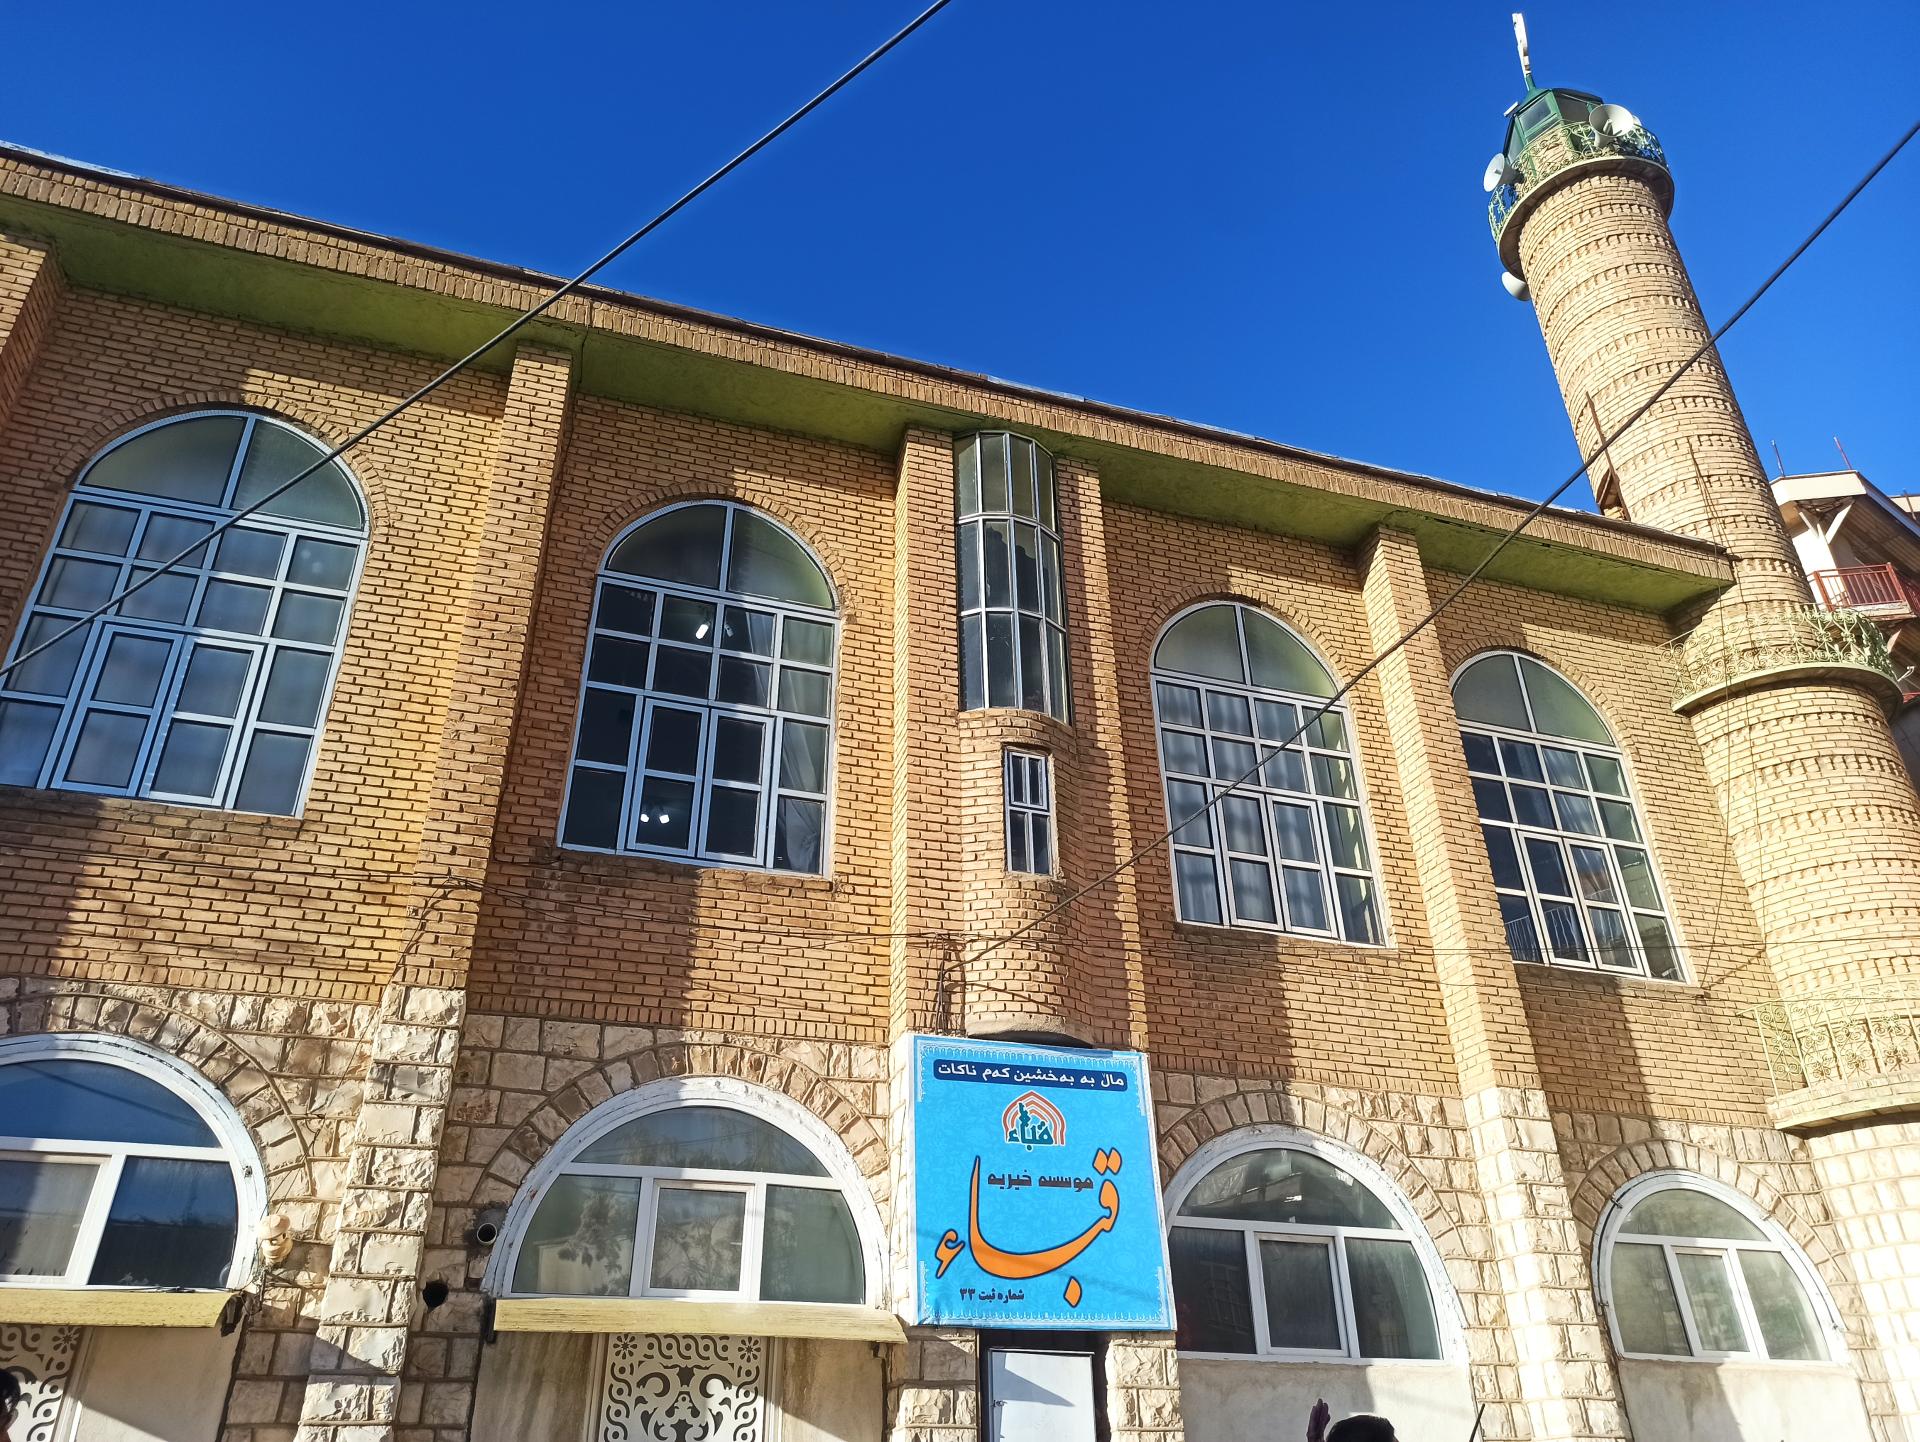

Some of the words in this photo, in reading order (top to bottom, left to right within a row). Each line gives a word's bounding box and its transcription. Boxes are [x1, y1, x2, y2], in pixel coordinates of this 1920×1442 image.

[938, 1063, 977, 1076] ناکات
[987, 1169, 1032, 1190] خیریه
[1038, 1175, 1094, 1192] موسسه
[978, 1287, 996, 1303] ثبت
[997, 1289, 1025, 1303] شماره
